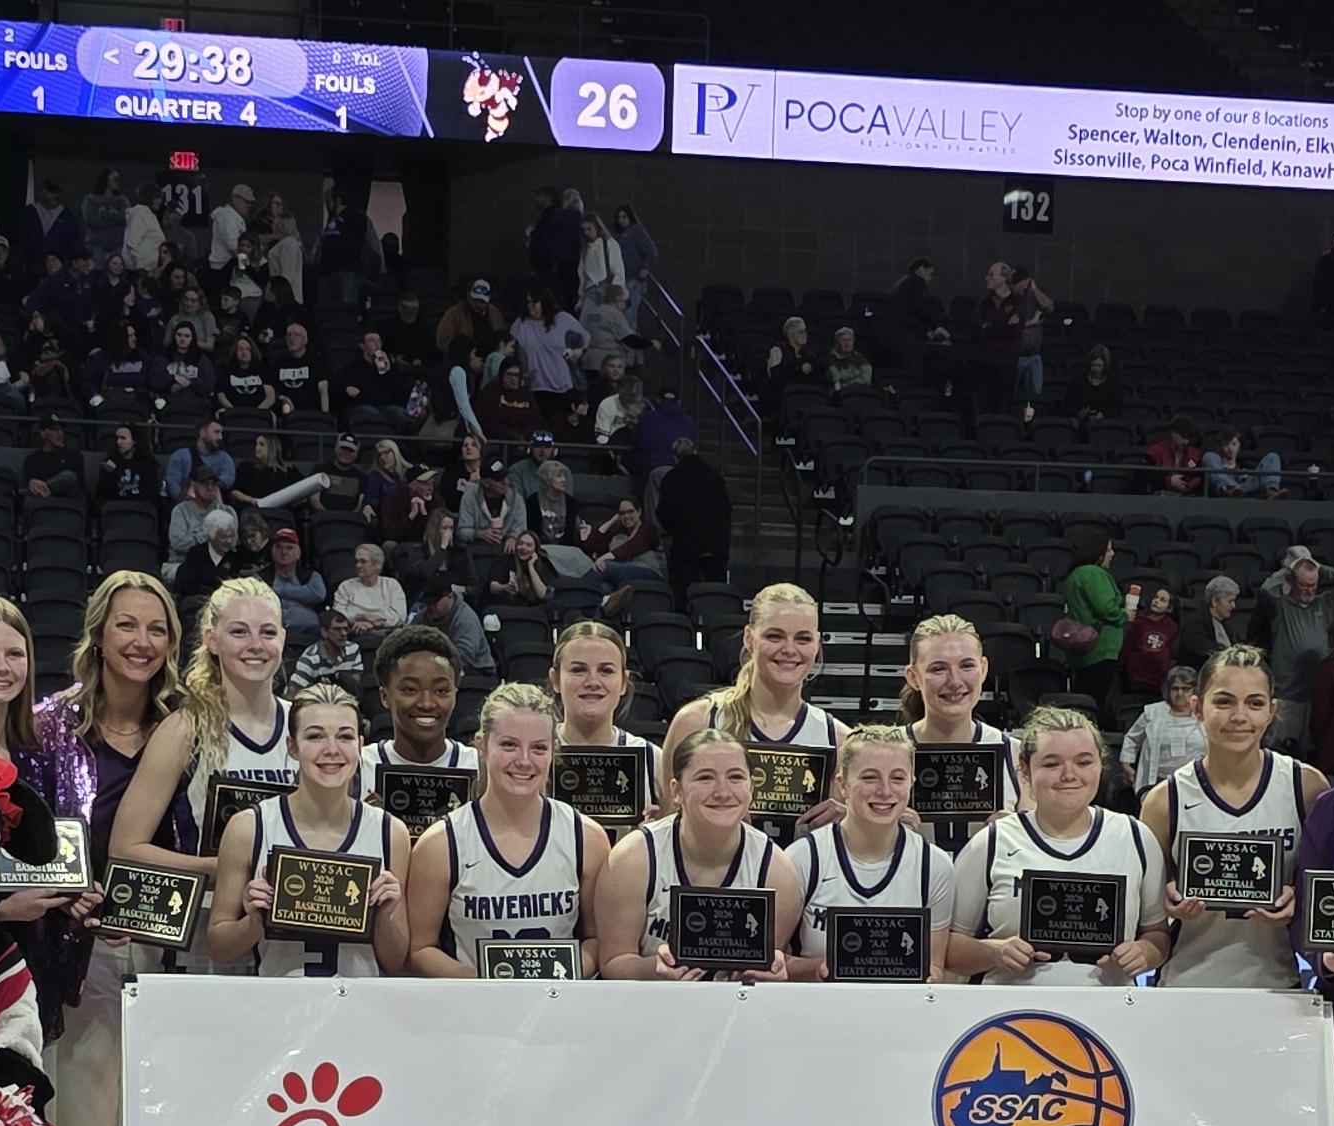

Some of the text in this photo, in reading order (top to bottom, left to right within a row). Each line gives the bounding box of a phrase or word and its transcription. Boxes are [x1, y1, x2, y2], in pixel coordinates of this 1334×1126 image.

[4, 29, 14, 42] 2
[4, 51, 68, 71] FOULS
[133, 41, 254, 86] 29:38
[315, 74, 376, 95] FOULS
[32, 86, 46, 111] 1
[115, 96, 258, 126] QUARTER 4
[577, 82, 637, 129] 26
[335, 105, 348, 129] 1
[1115, 103, 1329, 128] Stop by one of our 8 locations
[1068, 124, 1140, 146] Spencer,
[1144, 128, 1207, 149] Walton,
[1212, 132, 1302, 154] Clendenin,
[1054, 148, 1146, 171] Sissonville,
[1151, 154, 1189, 171] Poca
[1194, 156, 1267, 178] Winfield,
[162, 183, 203, 216] 131
[1010, 191, 1050, 221] 132
[570, 757, 621, 767] WVSSAC
[759, 755, 810, 767] WVSSAC
[929, 754, 980, 764] WVSSAC
[774, 766, 793, 776] 2026
[402, 776, 452, 789] WVSSAC
[773, 776, 792, 786] "AA"
[757, 792, 805, 804] BASKETBALL
[585, 804, 634, 814] CHAMPION
[750, 802, 812, 812] ATE CHAMPIO
[917, 800, 993, 811] STATE CHAMPION
[1205, 842, 1258, 854] WVSSAC
[1220, 853, 1241, 863] 2026
[299, 861, 354, 877] WVSSAC
[1221, 863, 1241, 872] "AA"
[1, 872, 82, 882] STATE CHAMPION
[128, 871, 179, 887] WVSSAC
[313, 874, 335, 886] 2026
[141, 885, 161, 895] 2026
[314, 884, 334, 895] "AA"
[1049, 881, 1101, 895] WVSSAC
[1204, 878, 1255, 890] BASKETBALL
[139, 894, 159, 904] "AA"
[1188, 887, 1270, 900] STATE CHAMPION
[295, 901, 347, 916] BASKETBALL
[464, 890, 575, 920] MAVERICKS
[698, 897, 750, 909] WVSSAC
[119, 908, 168, 923] BASKETBALL
[277, 909, 362, 928] STATE CHAMPION
[102, 915, 181, 936] STATE CHAMPION
[853, 917, 906, 929] WVSSAC
[1032, 930, 1113, 942] STATE CHAMPION
[504, 948, 557, 959] WVSSAC
[681, 946, 763, 960] STATE CHAMPION
[521, 960, 541, 969] 2026
[839, 967, 919, 977] STATE CHAMPION
[969, 1093, 1068, 1123] SSAC
